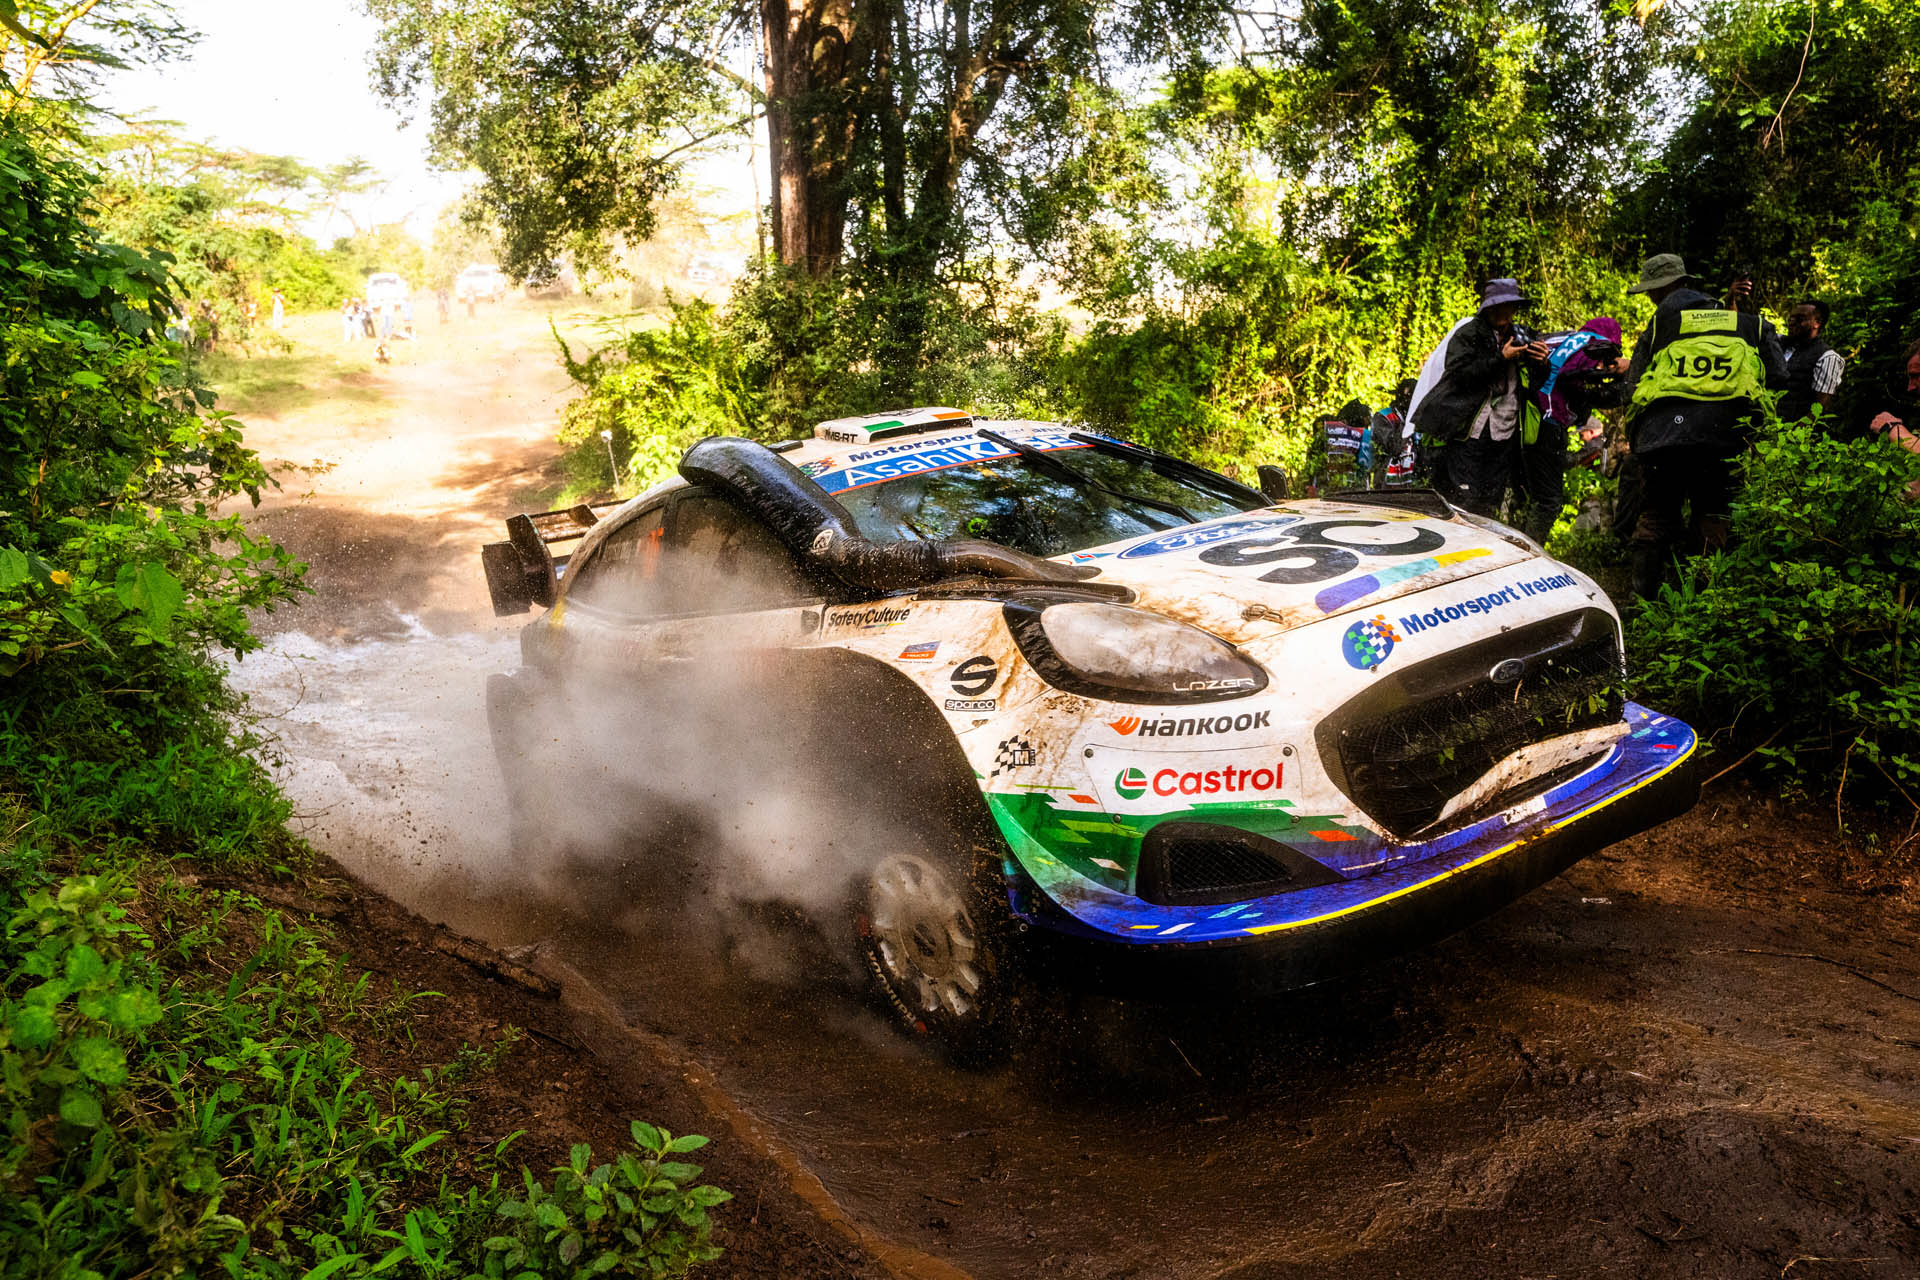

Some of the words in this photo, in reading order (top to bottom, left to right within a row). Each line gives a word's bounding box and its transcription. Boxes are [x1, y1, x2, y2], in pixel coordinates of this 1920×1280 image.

[1672, 355, 1733, 381] 195
[848, 432, 977, 463] Motorspor
[1155, 519, 1278, 550] Ford
[828, 606, 911, 630] SafetyCulture
[1399, 585, 1521, 636] Motorsport
[1517, 572, 1577, 598] Ireland
[945, 699, 996, 712] sparco
[1152, 762, 1284, 797] Castrol
